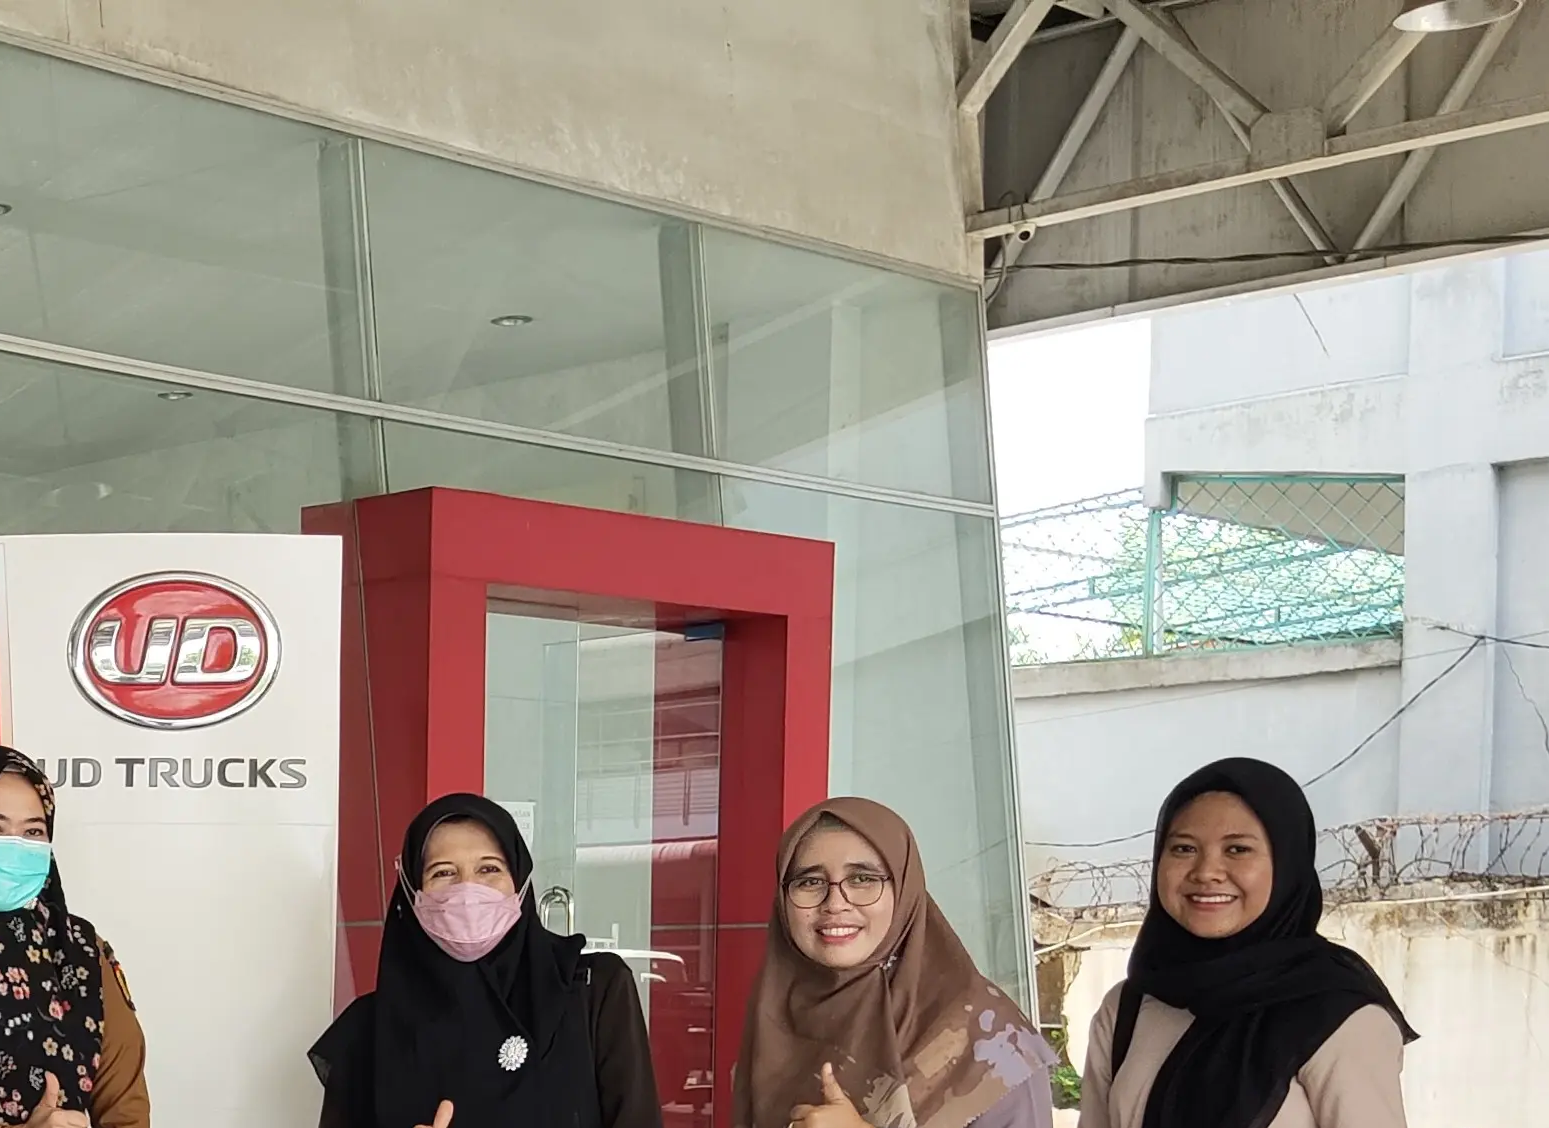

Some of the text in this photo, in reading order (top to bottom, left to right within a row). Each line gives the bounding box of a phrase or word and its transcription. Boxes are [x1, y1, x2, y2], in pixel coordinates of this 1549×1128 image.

[90, 616, 262, 684] UD
[37, 757, 307, 789] UD TRUCKS
